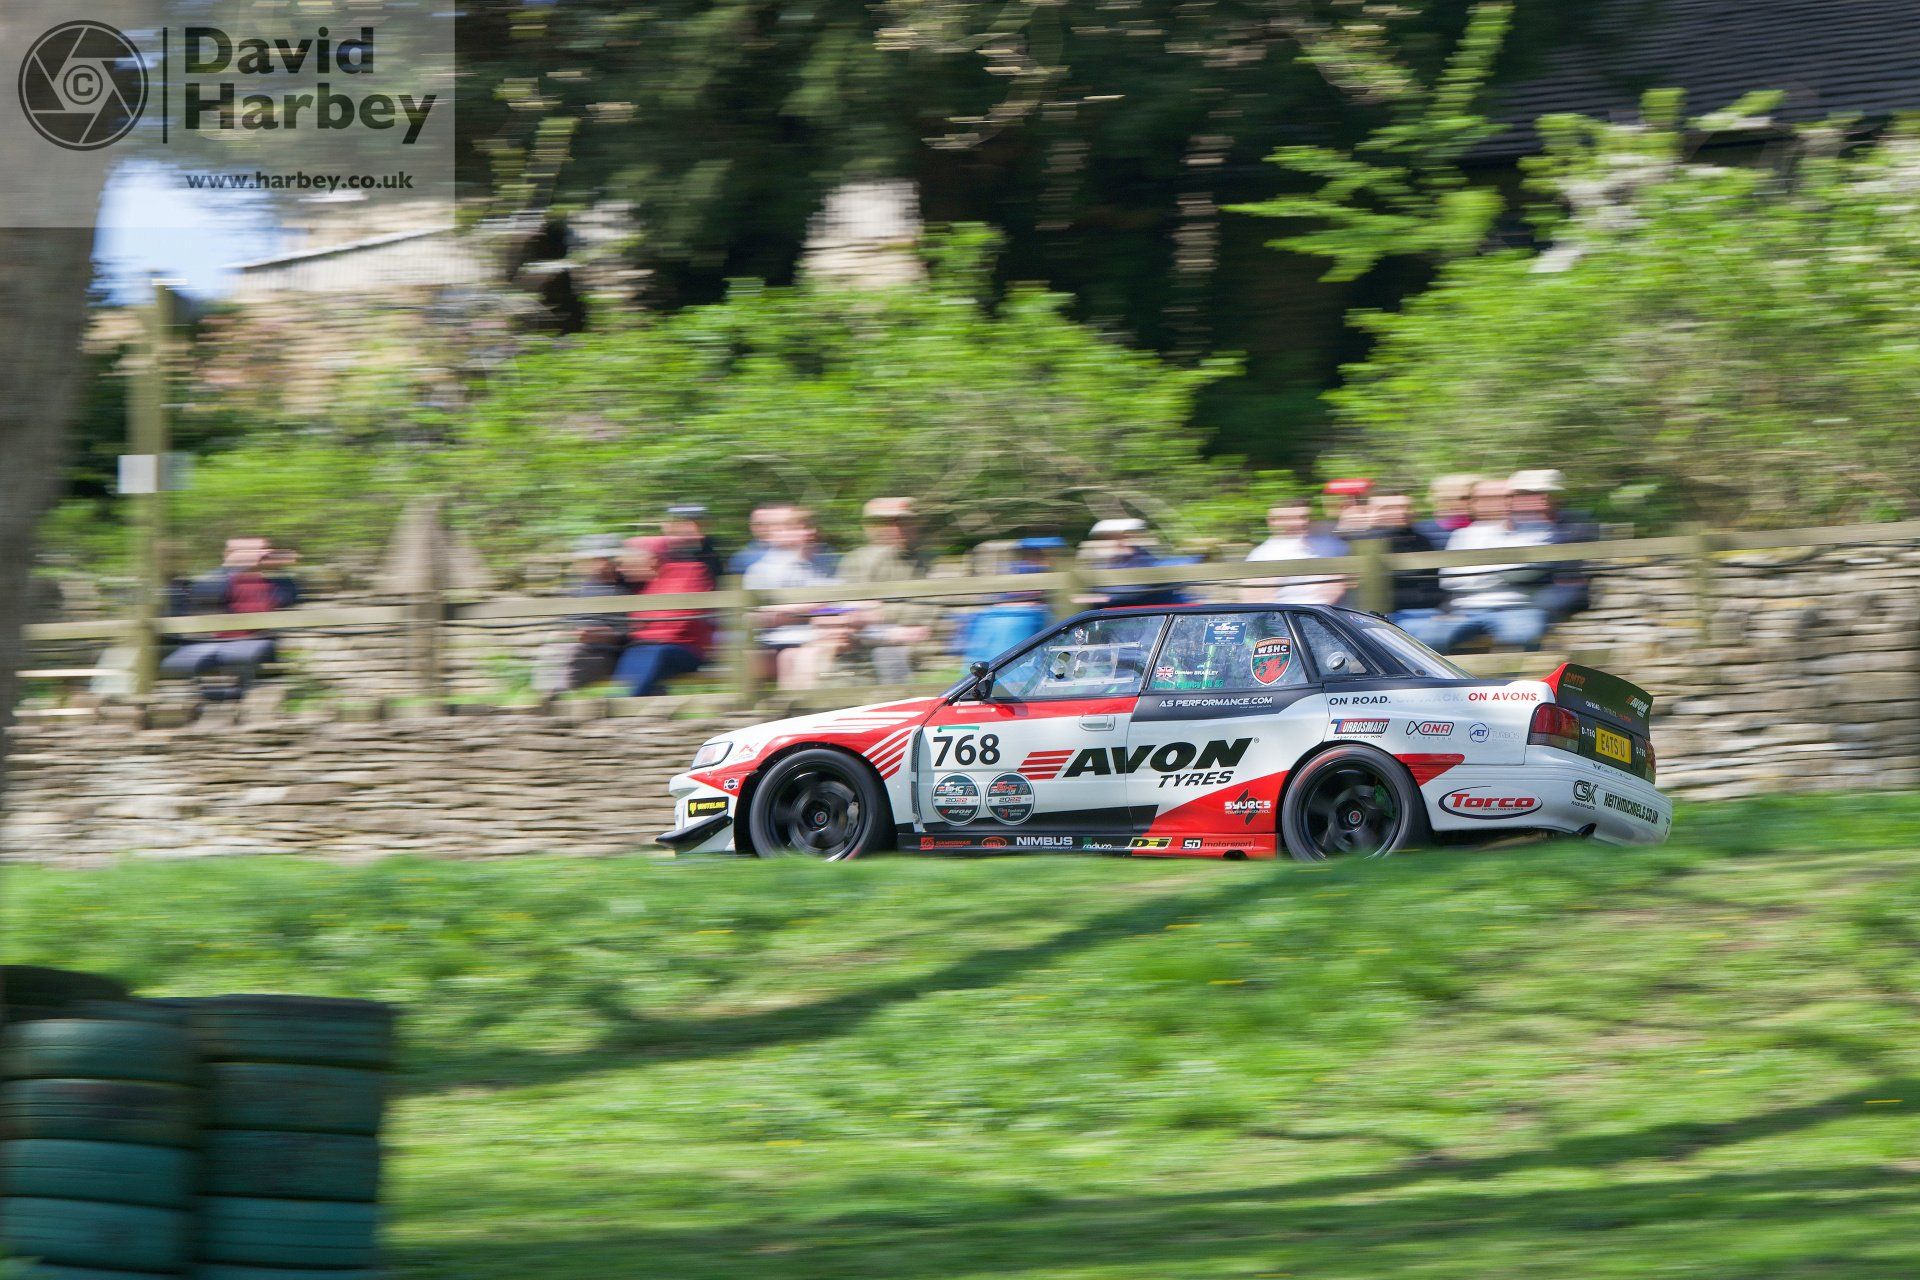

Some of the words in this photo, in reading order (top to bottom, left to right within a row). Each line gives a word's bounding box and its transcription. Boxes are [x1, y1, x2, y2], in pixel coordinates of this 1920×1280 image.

[1258, 645, 1287, 654] WSHC
[1160, 700, 1174, 708] AS
[1175, 697, 1273, 707] PERFORMANCE.COM
[1329, 697, 1349, 706] ON
[1352, 696, 1392, 705] ROAD.
[1468, 692, 1489, 701] ON
[1492, 692, 1540, 702] AVONS.
[1331, 718, 1390, 735] TURBOSMART
[933, 733, 1001, 767] 768
[1601, 734, 1619, 756] E4TS
[1620, 740, 1626, 758] U
[1063, 738, 1253, 778] AVON
[1158, 770, 1234, 788] TYRES
[697, 801, 726, 810] WHITELINE
[1450, 793, 1536, 808] Torco
[1016, 837, 1073, 846] NIMBUS
[1183, 839, 1201, 849] SD
[1204, 840, 1253, 848] motorsport
